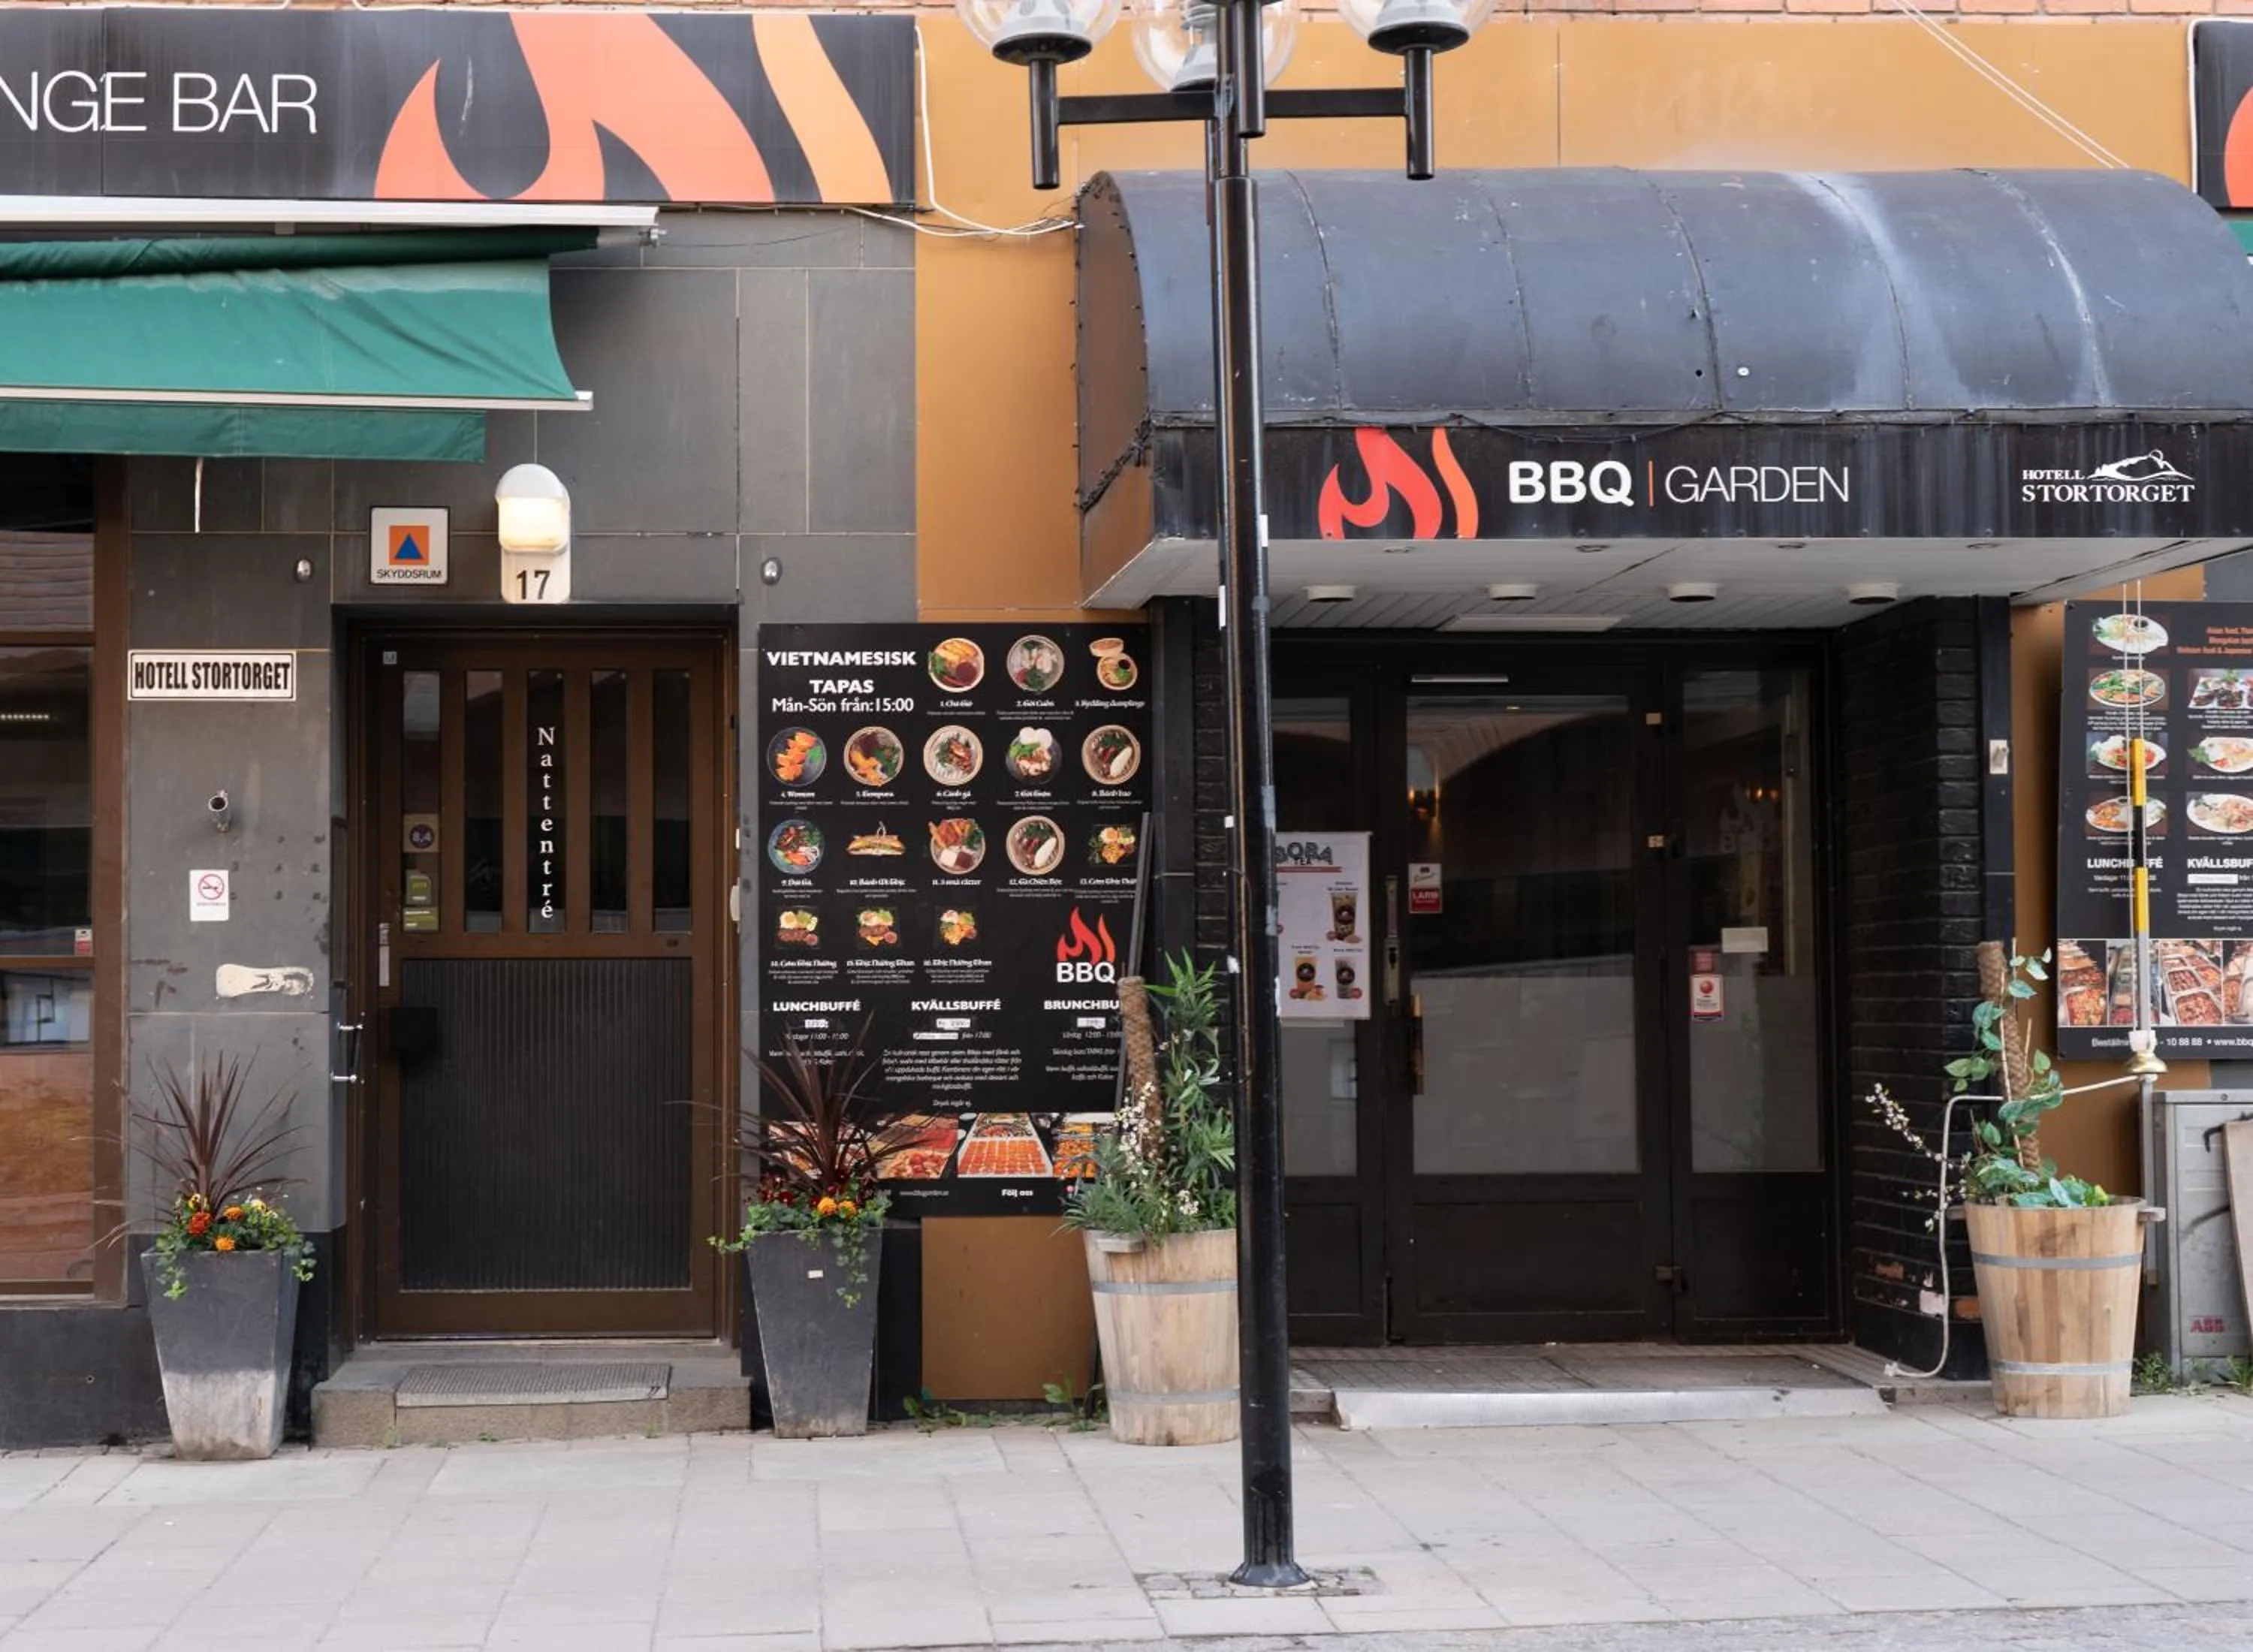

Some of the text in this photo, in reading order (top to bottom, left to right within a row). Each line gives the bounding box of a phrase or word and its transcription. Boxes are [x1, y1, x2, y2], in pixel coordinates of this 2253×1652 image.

[172, 73, 318, 134] BAR
[2022, 469, 2085, 481] HOTELL
[1508, 460, 1850, 508] BBQ GARDEN
[2022, 484, 2195, 502] STORTORGET
[376, 568, 442, 580] SKYDDSRUM
[516, 568, 550, 600] 17
[766, 650, 918, 667] VIETNAMESISK
[134, 661, 291, 692] HOTELL STORTORGET
[809, 679, 875, 694] TAPAS
[771, 696, 836, 713] Mån-Sön
[536, 726, 556, 921] Nattentré
[2087, 855, 2164, 869] LUNCHBFÉ
[1056, 961, 1116, 984] BBQ
[772, 998, 861, 1012] LUNCHBUFFÉ
[910, 997, 1002, 1011] KVÄLLSBUFFÉ
[1043, 999, 1120, 1011] BRUNCHBU
